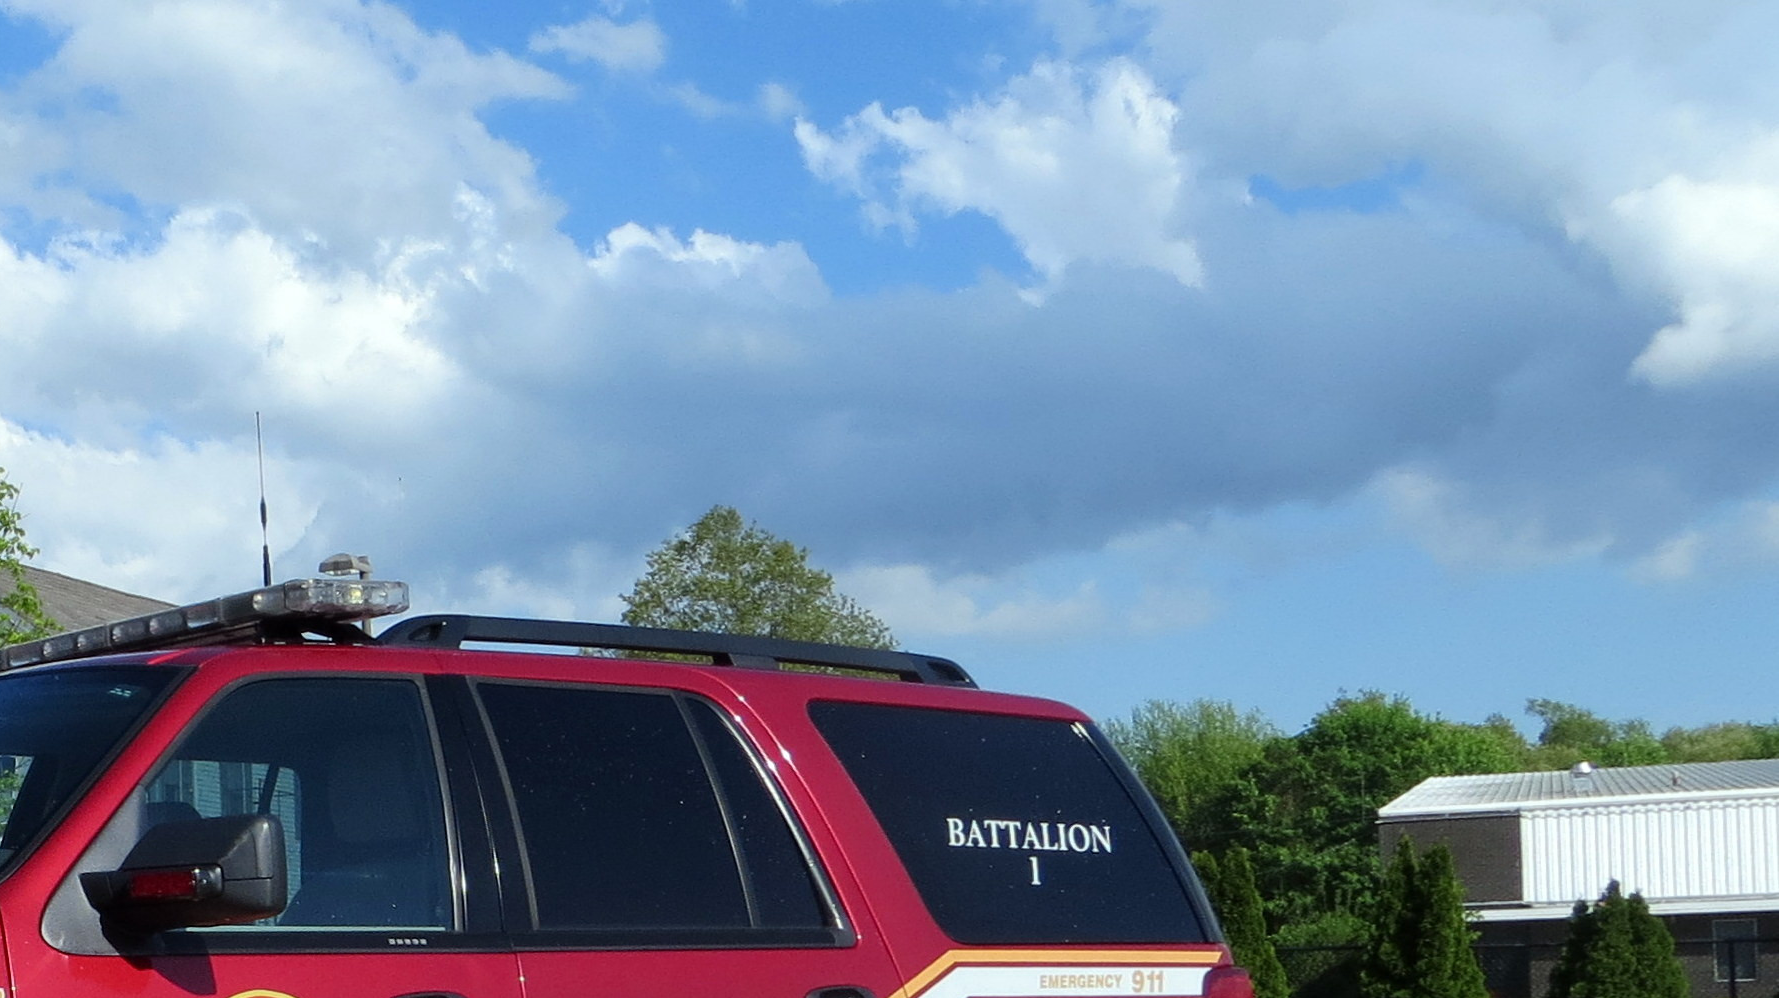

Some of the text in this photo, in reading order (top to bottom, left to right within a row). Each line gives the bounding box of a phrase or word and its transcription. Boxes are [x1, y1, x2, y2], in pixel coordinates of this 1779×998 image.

[947, 818, 1112, 853] BATTALION
[1029, 856, 1041, 885] 1
[1039, 970, 1164, 993] EMERGENCY 911
